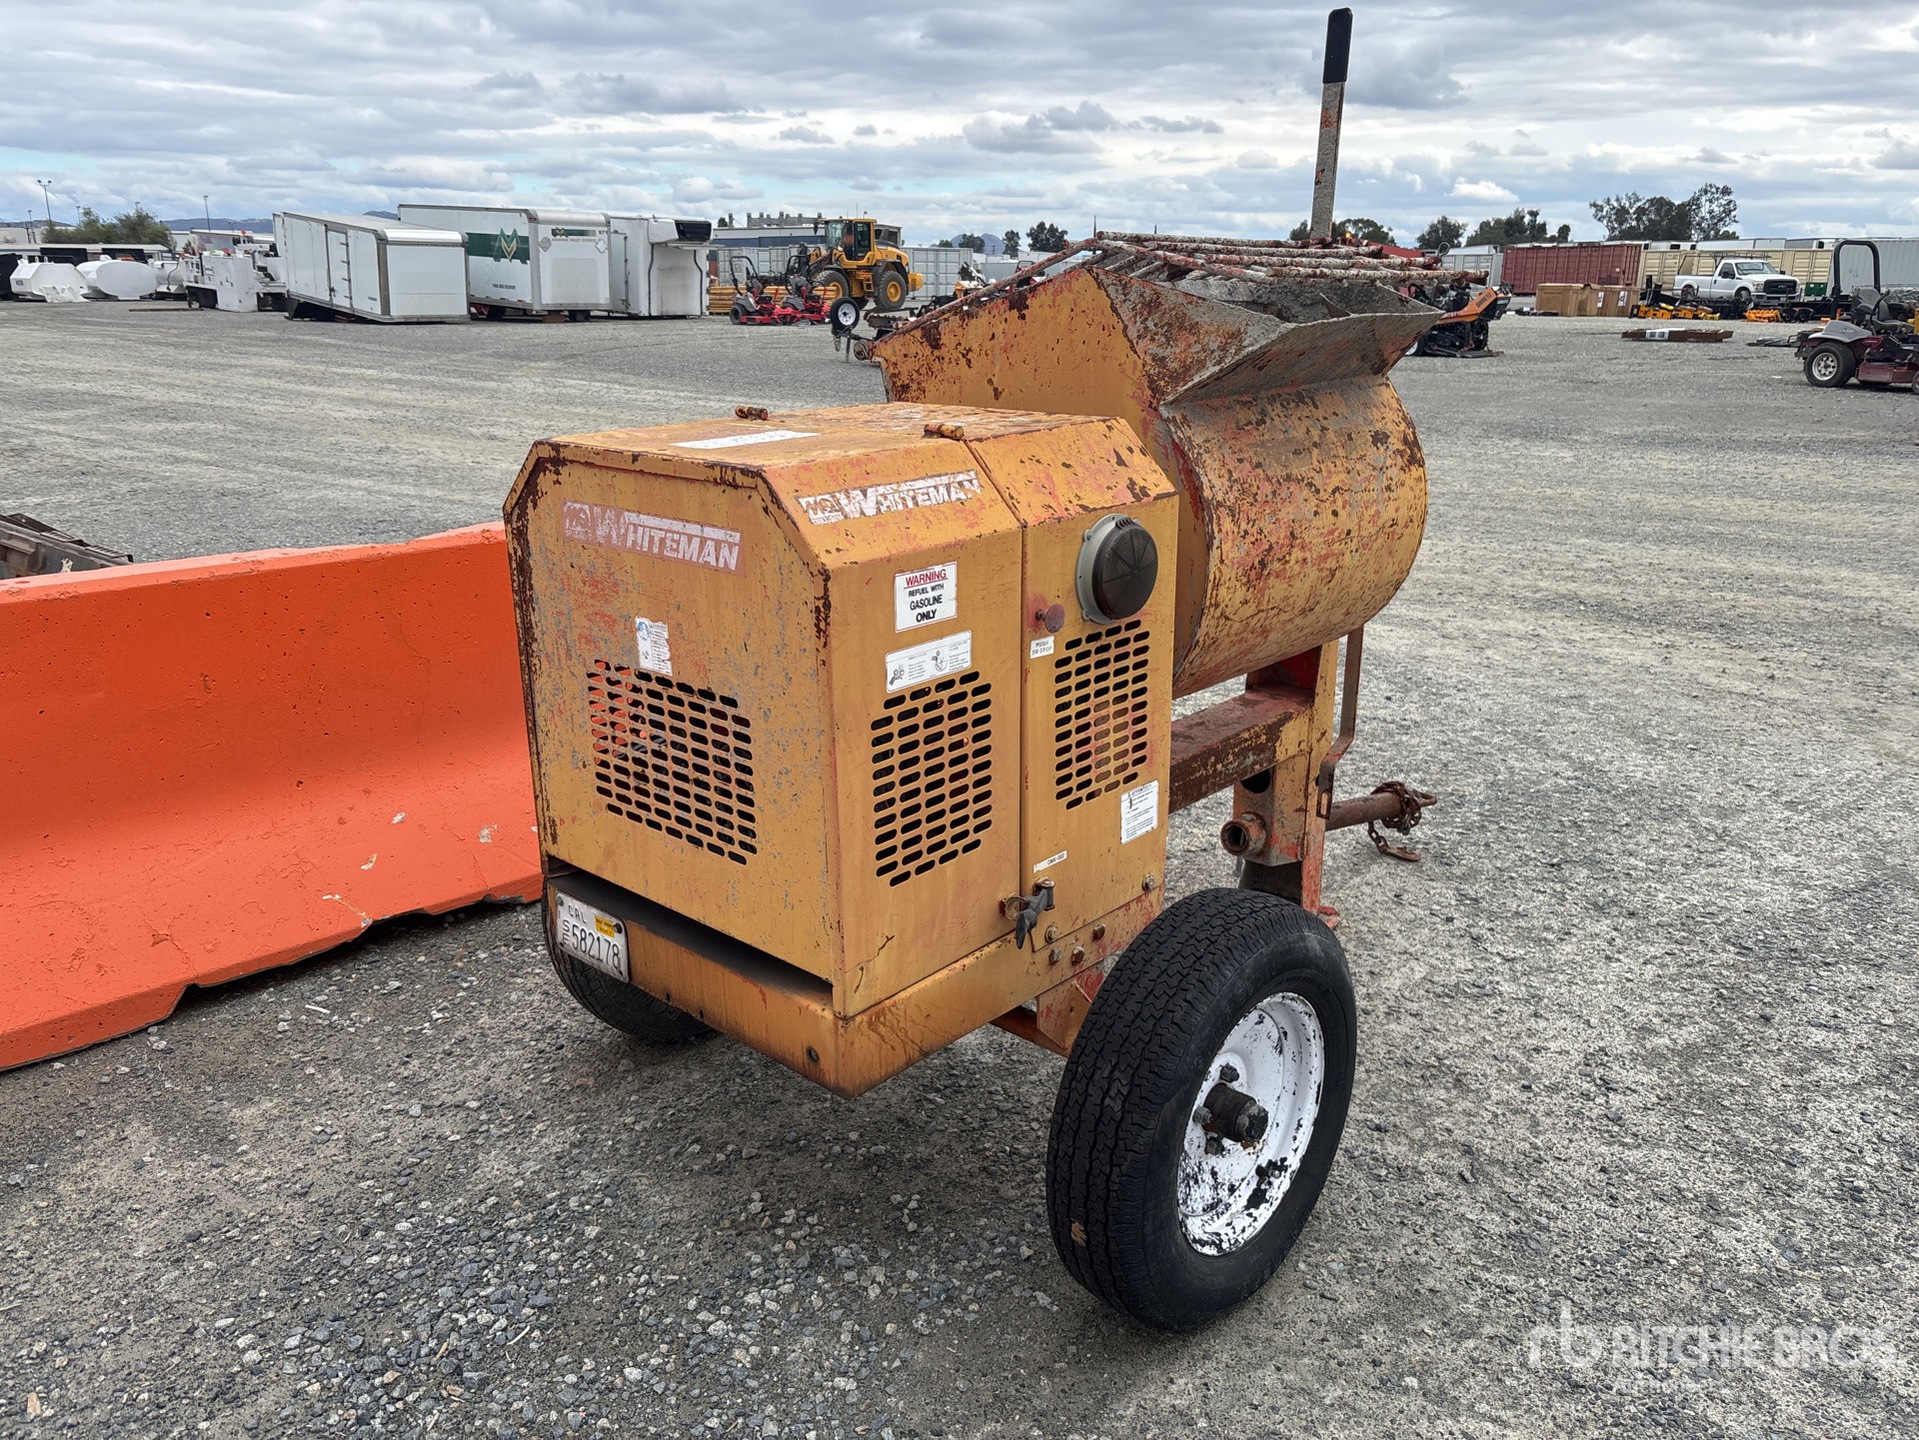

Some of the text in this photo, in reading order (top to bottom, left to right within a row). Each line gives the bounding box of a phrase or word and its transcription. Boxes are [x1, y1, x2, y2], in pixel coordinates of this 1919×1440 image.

[838, 472, 982, 518] WHITEMAN
[593, 506, 739, 571] WHITEMAN
[906, 569, 947, 587] WARNING
[908, 583, 945, 598] REFUEL WITH
[909, 594, 943, 611] GASOLINE
[915, 609, 937, 623] ONLY
[572, 924, 621, 970] 582178
